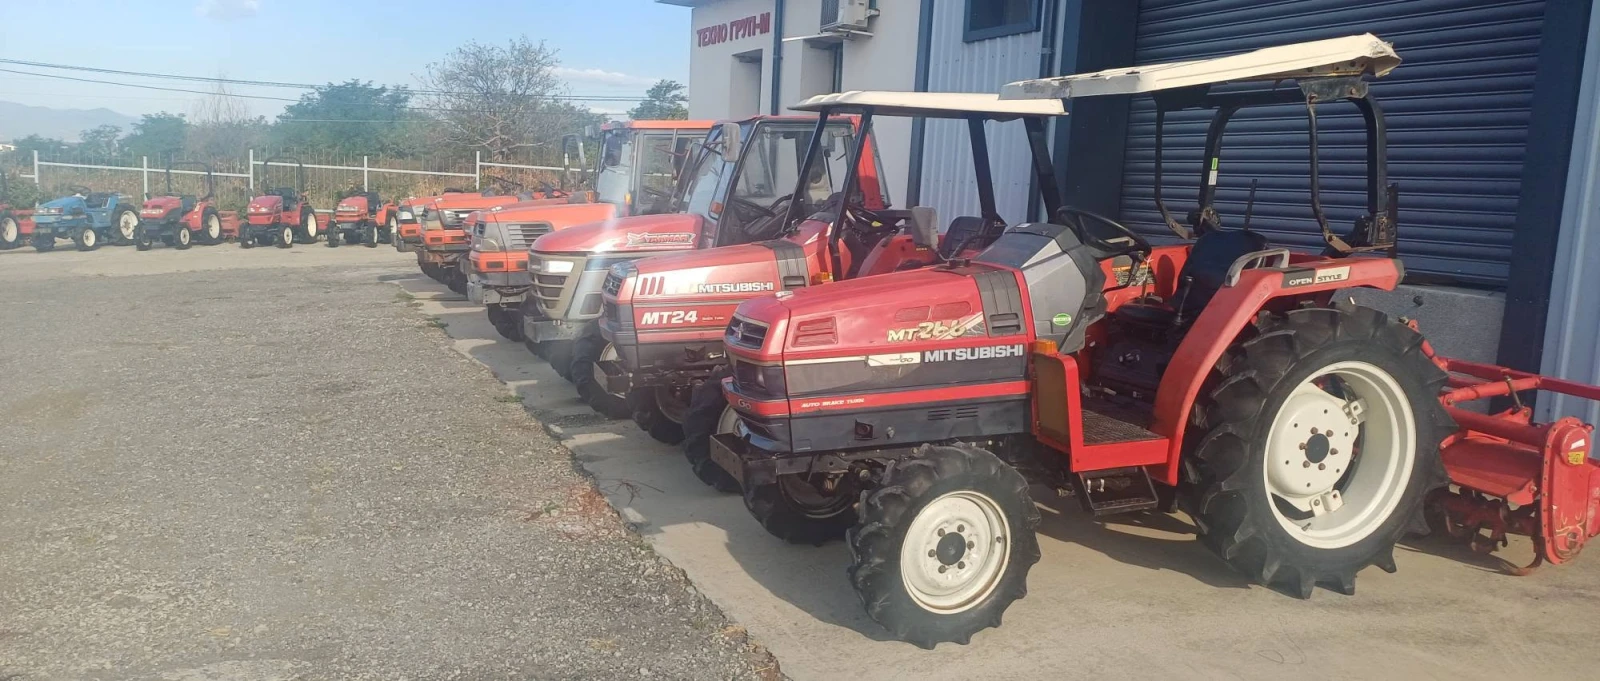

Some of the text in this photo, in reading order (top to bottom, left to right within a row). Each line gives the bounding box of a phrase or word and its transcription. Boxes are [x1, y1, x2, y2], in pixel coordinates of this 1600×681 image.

[697, 12, 771, 47] ТЕХНО ГРУП-М
[1289, 273, 1342, 286] OPEN STYLE
[698, 282, 774, 294] MITSUBISHI
[641, 310, 698, 325] MT24
[924, 344, 1024, 363] MITSUBISHI
